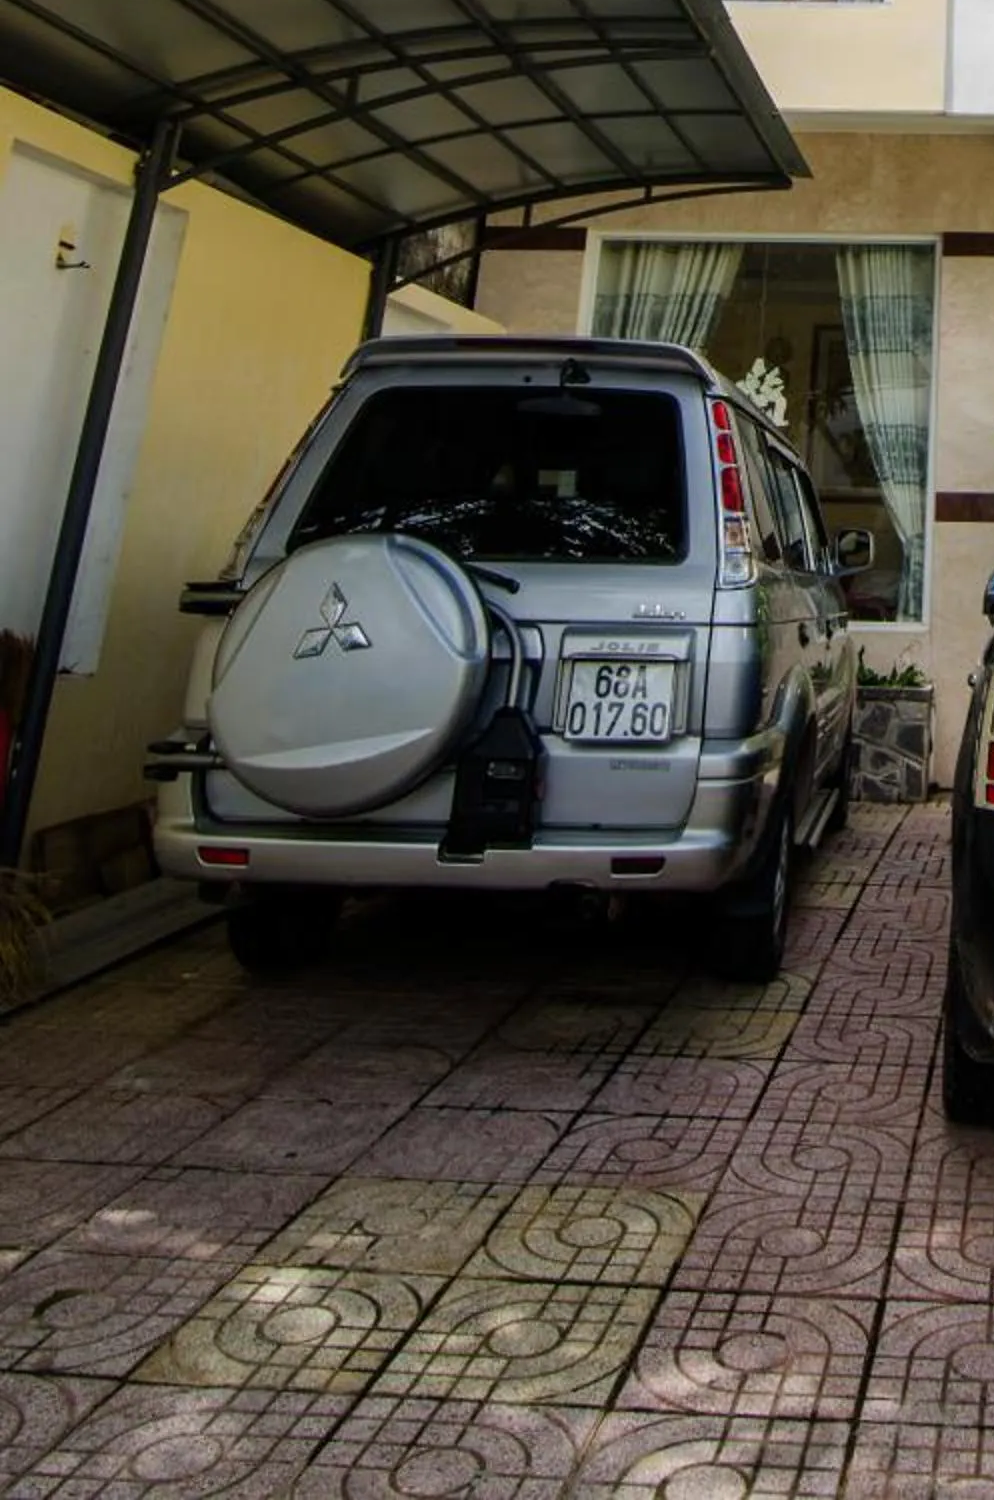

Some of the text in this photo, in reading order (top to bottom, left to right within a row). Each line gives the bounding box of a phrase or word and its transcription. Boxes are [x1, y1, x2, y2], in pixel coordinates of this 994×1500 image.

[590, 641, 661, 653] JOLIE
[595, 665, 648, 699] 68A
[568, 702, 667, 736] 017.60
